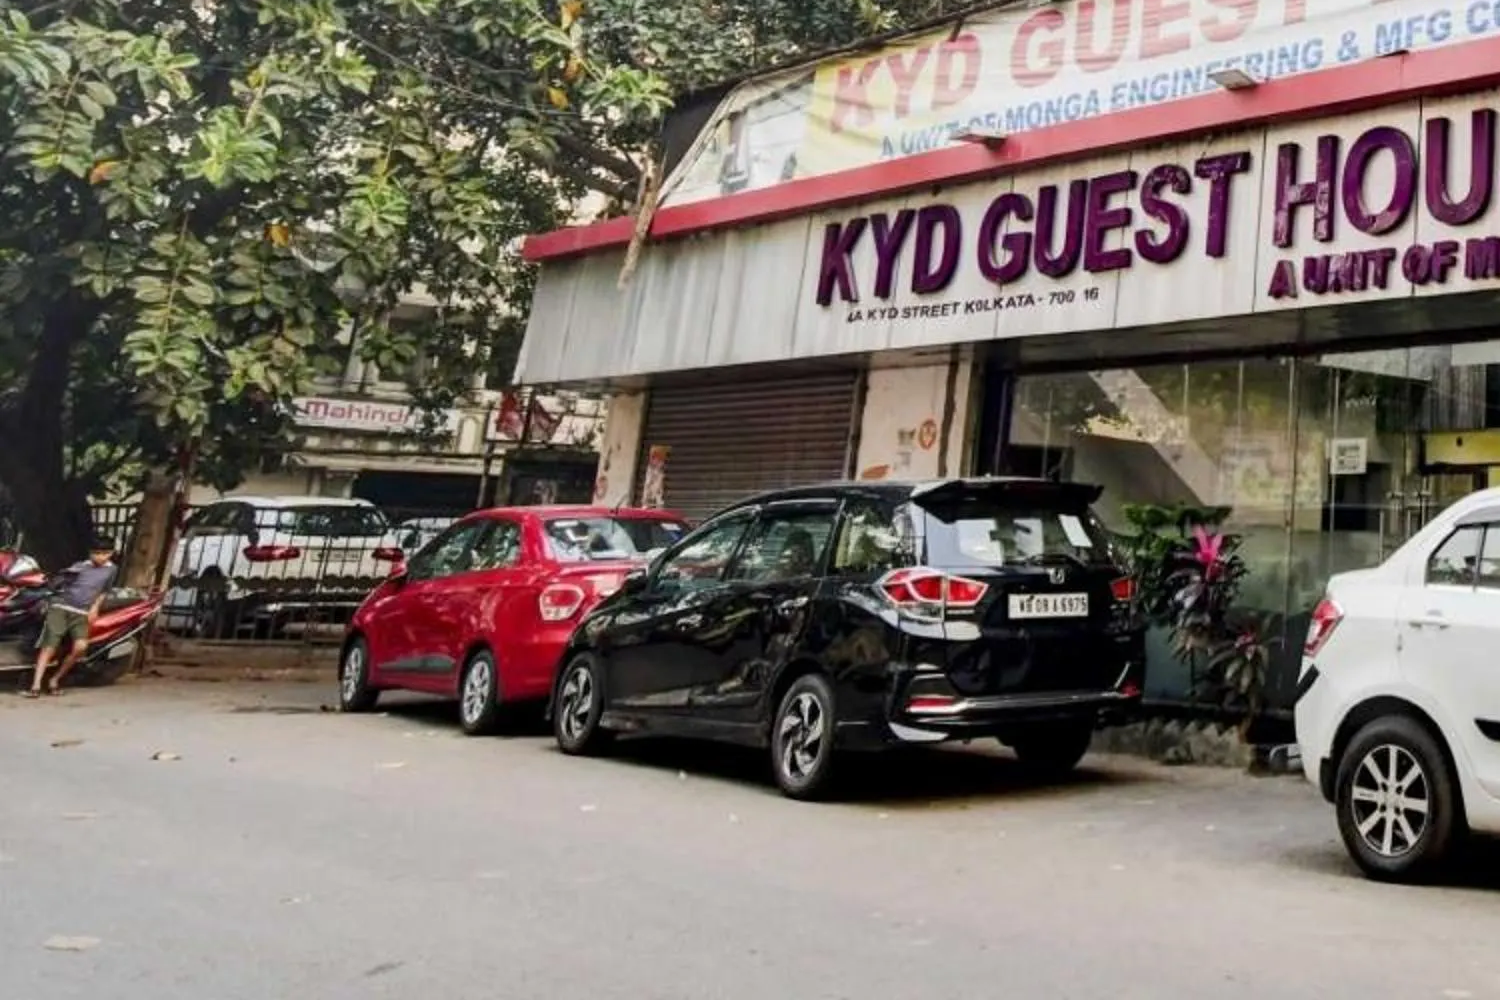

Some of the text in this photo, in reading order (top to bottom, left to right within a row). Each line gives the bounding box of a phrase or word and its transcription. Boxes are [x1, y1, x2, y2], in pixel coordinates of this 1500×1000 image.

[830, 33, 982, 134] KYD
[1006, 88, 1100, 132] MONGA
[1337, 30, 1359, 61] &
[1375, 6, 1452, 56] MFG
[815, 203, 961, 306] KYD
[977, 150, 1251, 284] GUEST
[867, 305, 899, 321] KYD
[901, 301, 962, 319] STREET
[1049, 289, 1076, 305] 700
[1268, 260, 1298, 299] A
[1303, 247, 1397, 295] UNIT
[1402, 240, 1459, 285] OF
[305, 400, 411, 425] Mahindr
